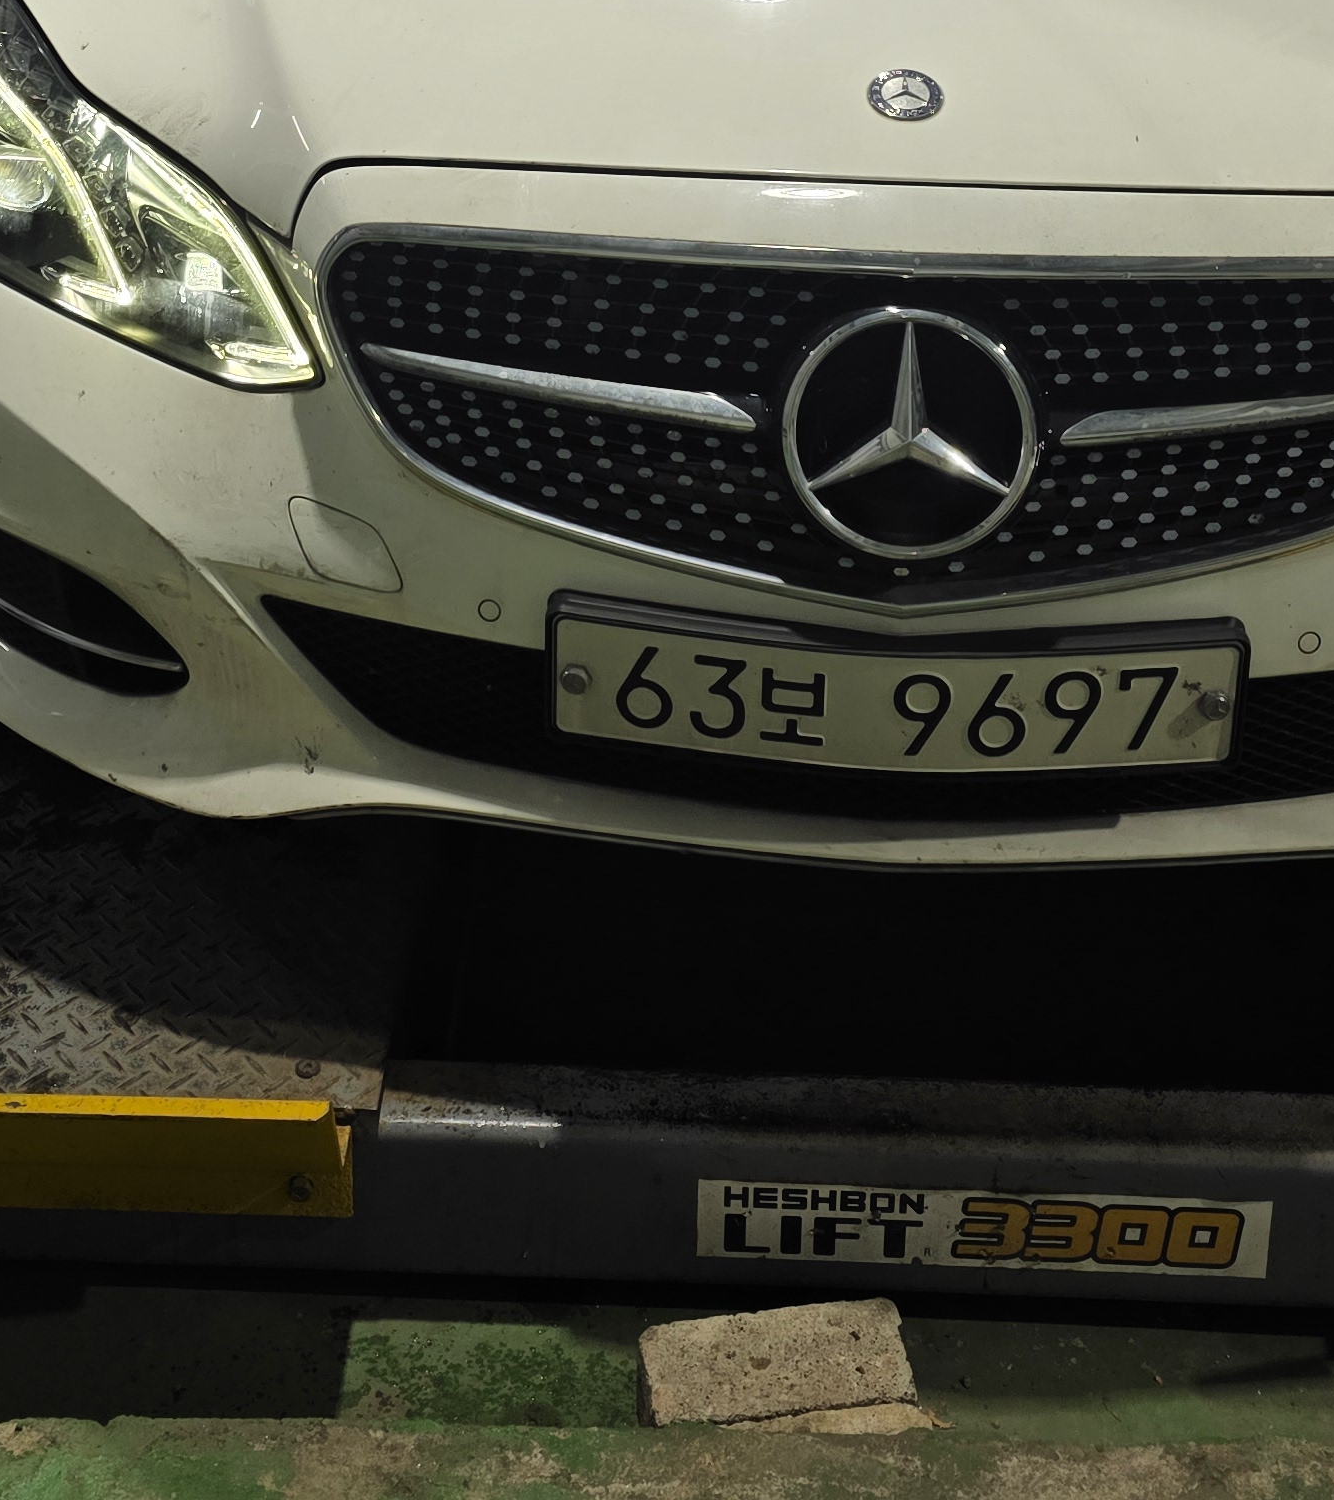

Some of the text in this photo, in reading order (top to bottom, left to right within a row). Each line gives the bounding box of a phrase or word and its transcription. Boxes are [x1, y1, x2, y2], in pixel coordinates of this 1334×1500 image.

[614, 645, 1181, 759] 63보 9697
[723, 1185, 926, 1215] HESHBON
[723, 1196, 1246, 1270] LIFT 3300
